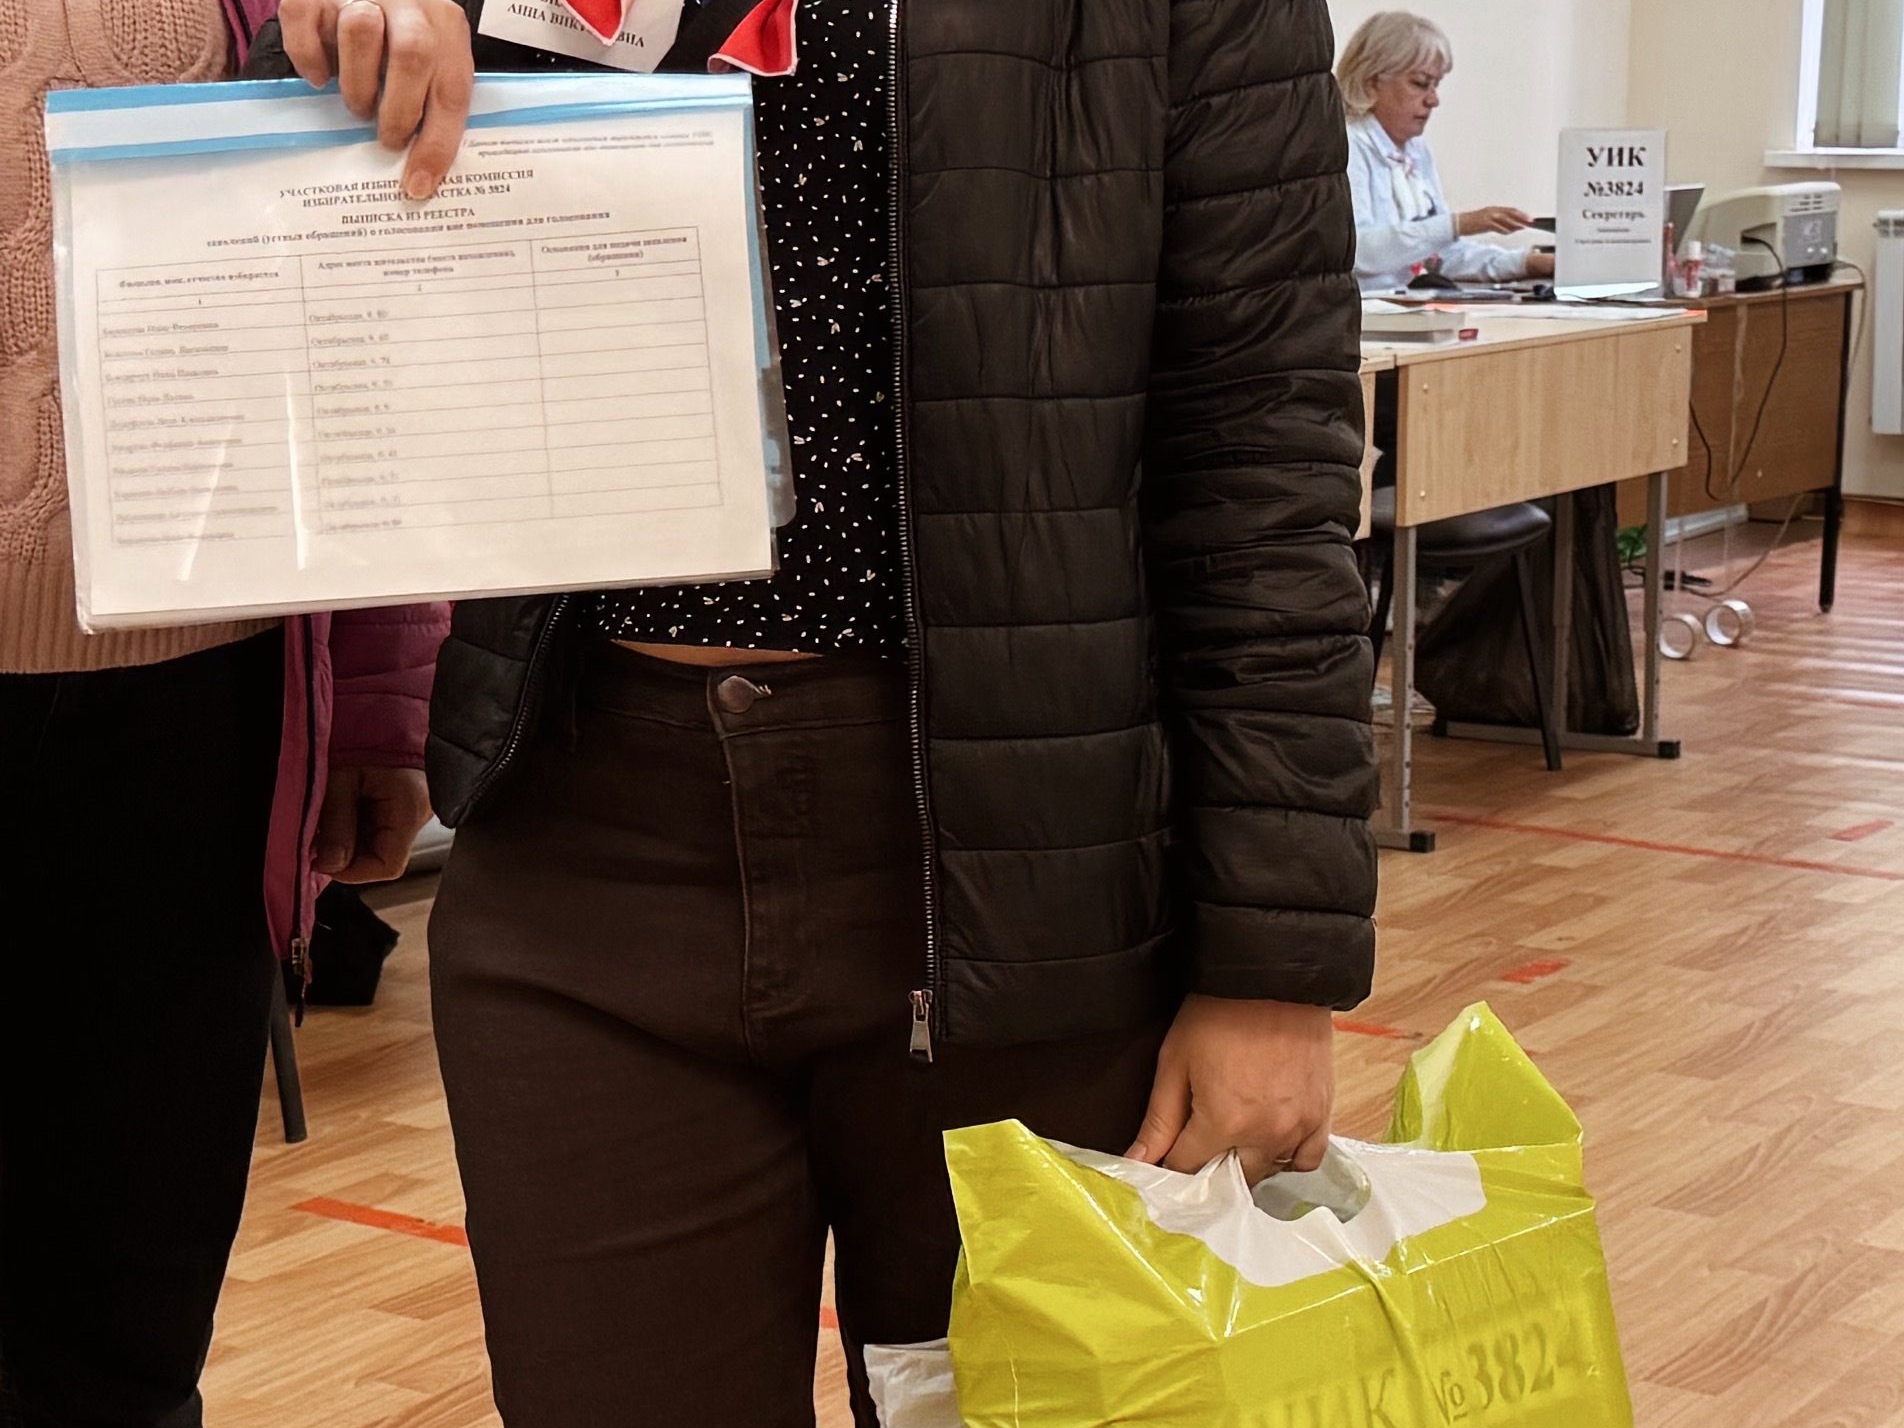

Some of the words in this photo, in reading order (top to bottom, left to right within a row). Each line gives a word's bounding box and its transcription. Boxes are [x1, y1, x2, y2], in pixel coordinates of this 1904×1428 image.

[1586, 146, 1647, 168] УИК
[280, 182, 359, 199] УЧАСТКОВАЯ
[465, 169, 534, 183] КОМИССИЯ
[1583, 180, 1644, 197] №3824
[342, 212, 404, 225] ВЫПИСКА
[406, 211, 422, 222] ИЗ
[424, 208, 476, 221] РЕЕСТРА
